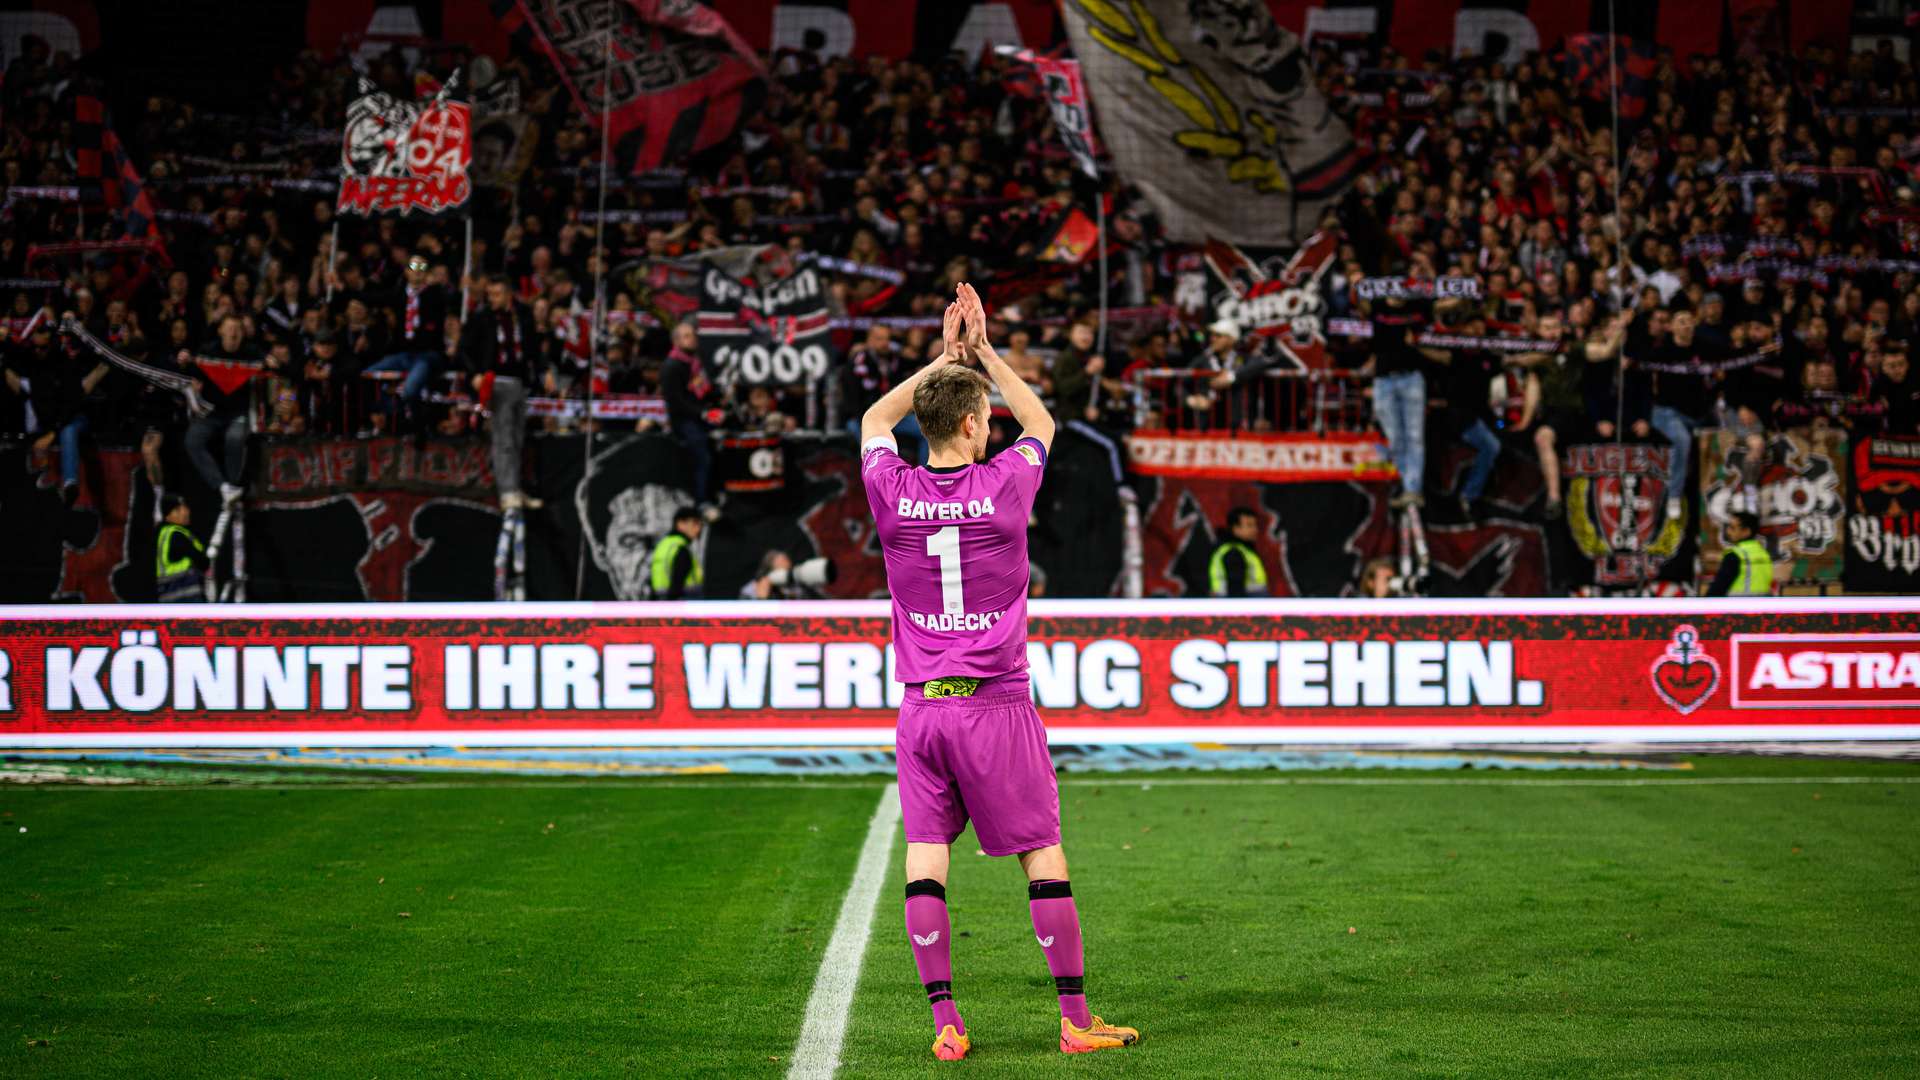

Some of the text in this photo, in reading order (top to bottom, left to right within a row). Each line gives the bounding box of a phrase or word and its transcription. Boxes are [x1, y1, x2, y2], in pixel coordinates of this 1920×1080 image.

[336, 175, 472, 216] INFERNO
[714, 344, 828, 383] 2009
[1562, 447, 1672, 475] JUGEN
[897, 496, 995, 520] BAYER 04
[926, 525, 965, 614] 1
[46, 630, 411, 711] KÖNNTE
[445, 644, 655, 711] IHRE
[683, 640, 1141, 711] WERNG
[1170, 640, 1544, 708] STEHEN.
[1750, 651, 1920, 690] ASTRA
